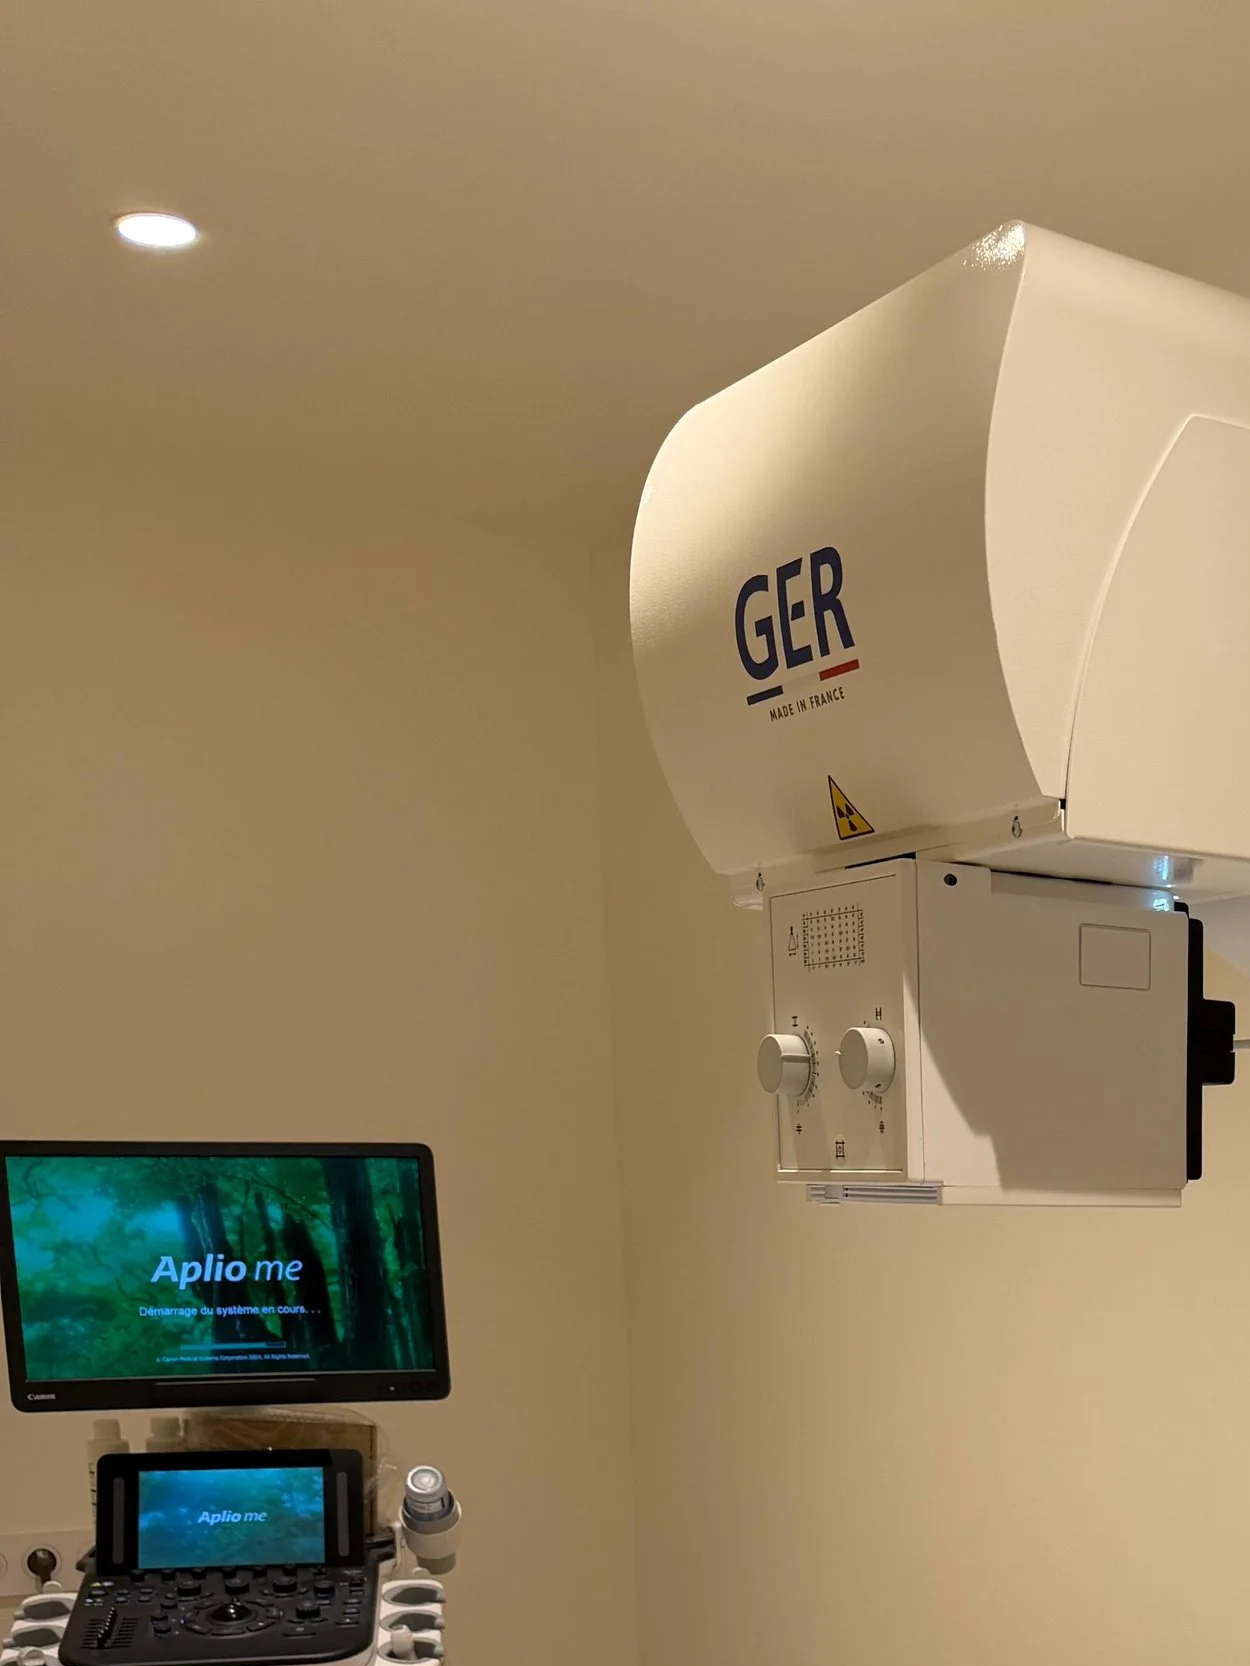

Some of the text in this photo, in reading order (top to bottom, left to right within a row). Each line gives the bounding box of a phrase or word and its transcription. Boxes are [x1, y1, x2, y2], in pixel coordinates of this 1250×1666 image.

[735, 546, 855, 681] GER
[769, 686, 845, 722] MADE IN FRANCE
[150, 1254, 303, 1290] Aplio me
[140, 1306, 197, 1318] Démarrage
[200, 1305, 214, 1316] du
[216, 1304, 258, 1318] système
[262, 1306, 275, 1314] en
[198, 1510, 268, 1526] Aplio me
